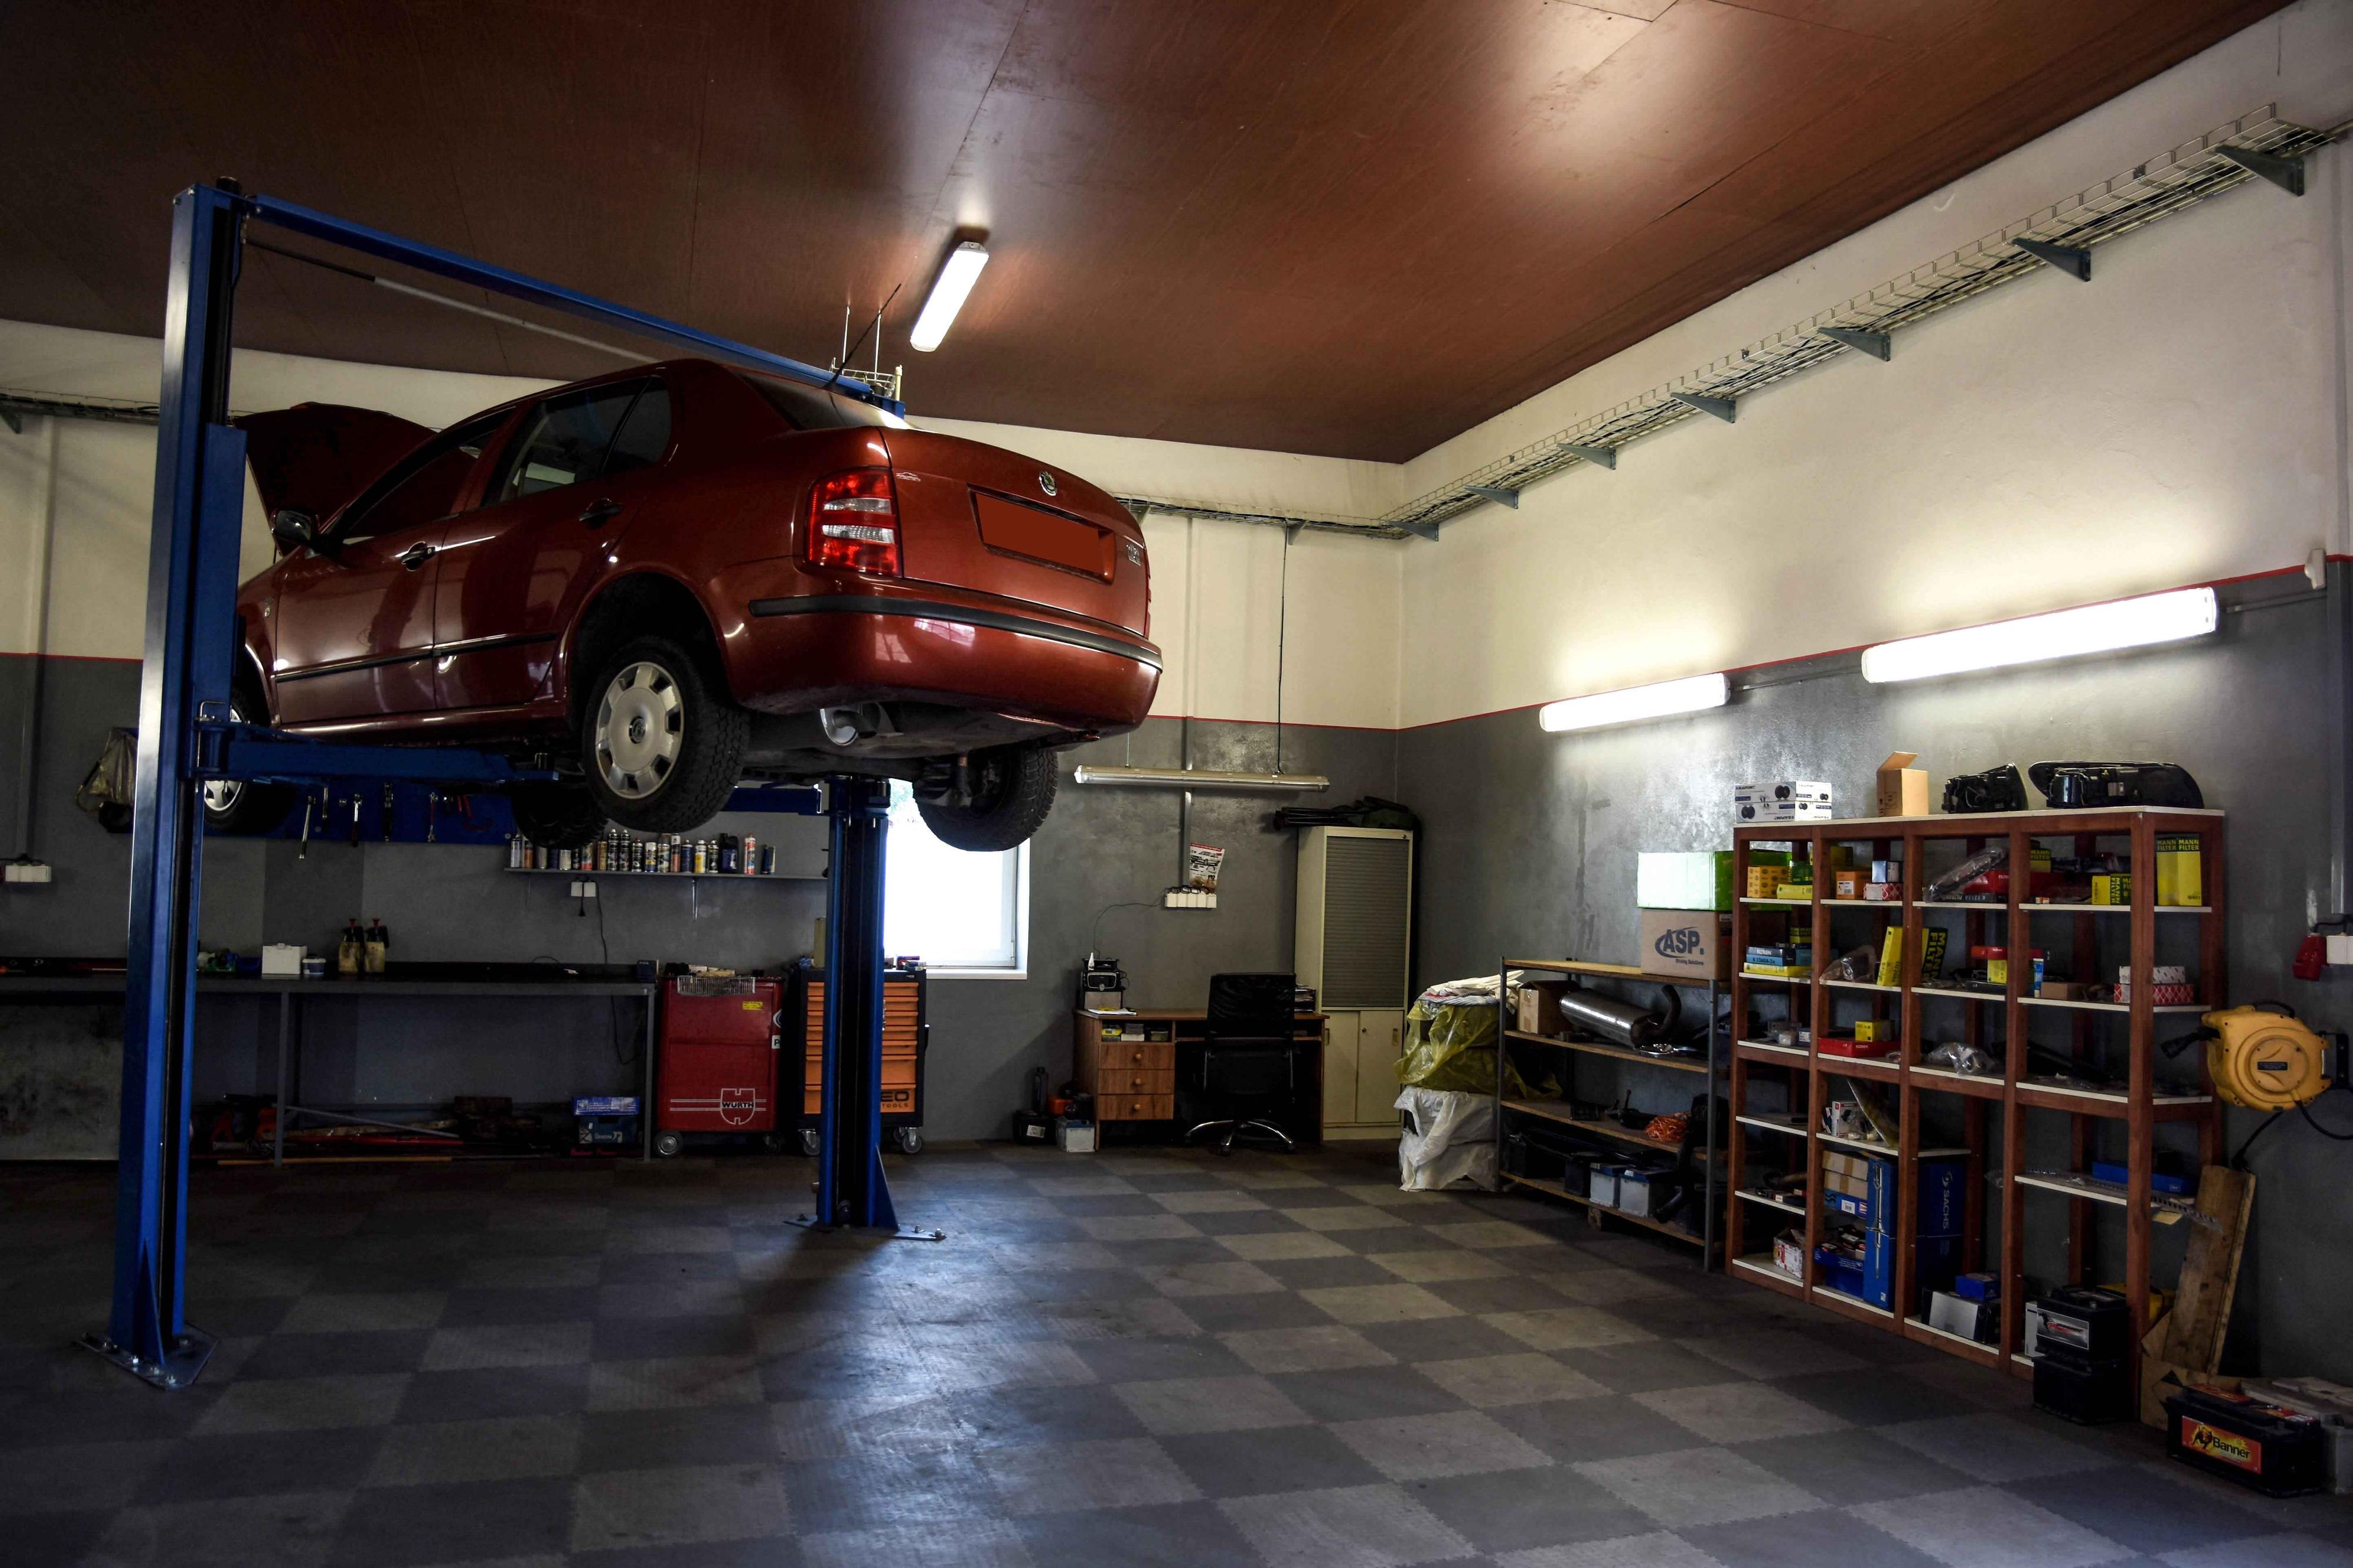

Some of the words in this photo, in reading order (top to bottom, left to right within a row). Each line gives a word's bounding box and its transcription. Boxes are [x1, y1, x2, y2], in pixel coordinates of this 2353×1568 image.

[1922, 932, 1938, 982] FILTER
[1931, 932, 1947, 979] MANN
[881, 1091, 909, 1102] EO
[2212, 1436, 2250, 1459] Banner
